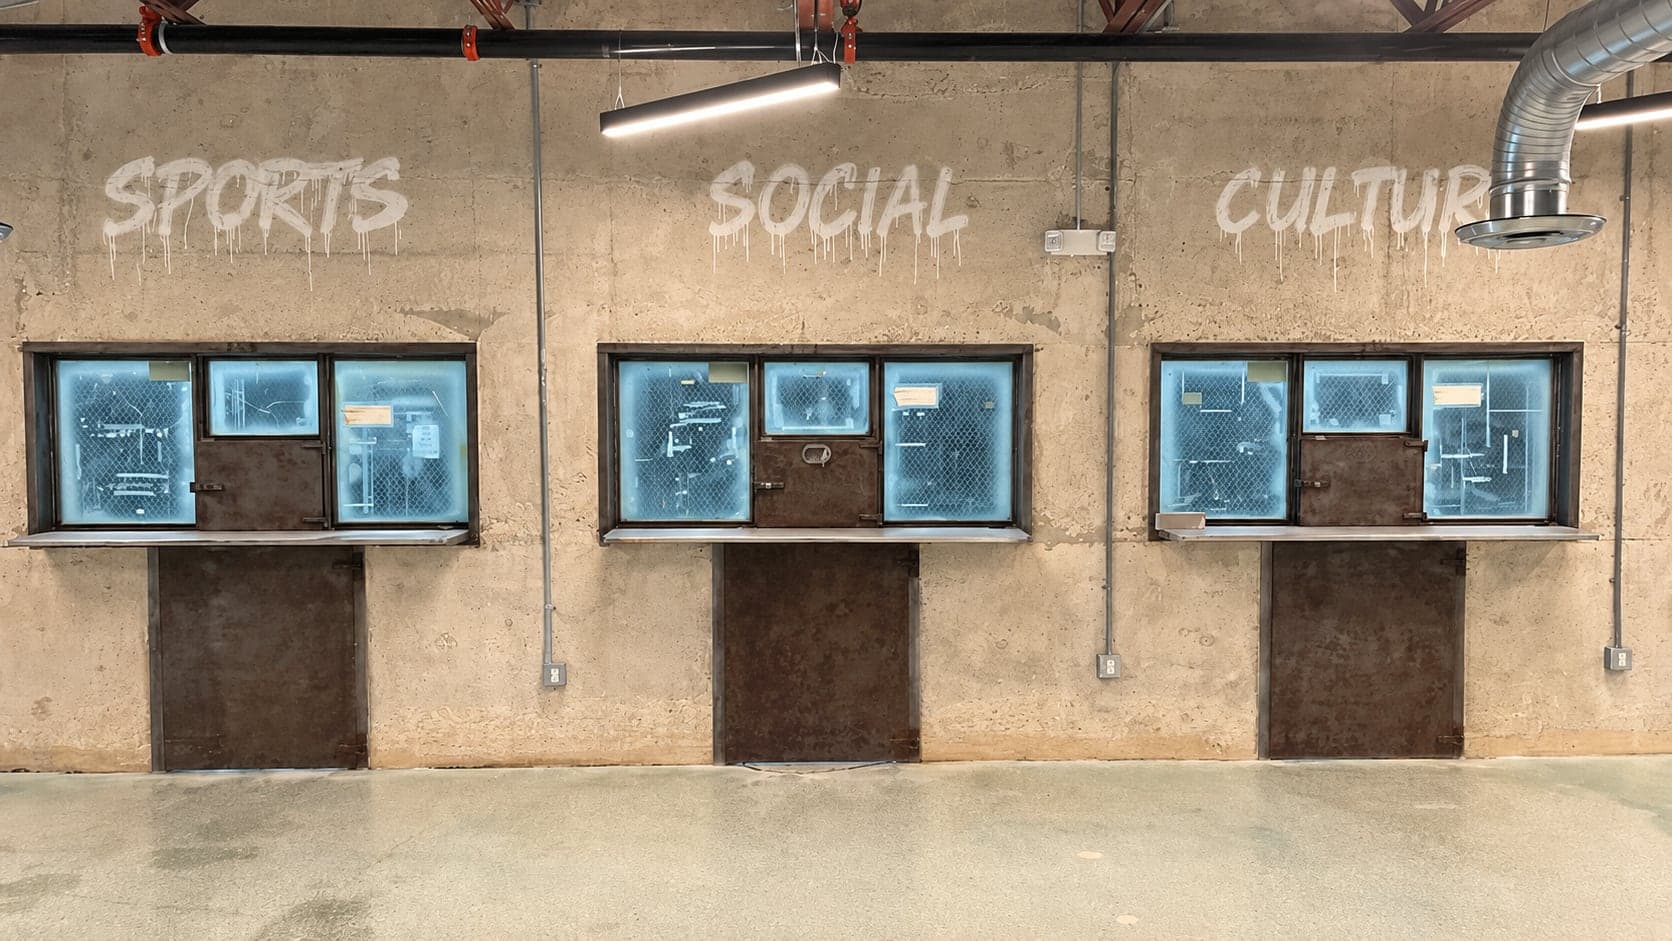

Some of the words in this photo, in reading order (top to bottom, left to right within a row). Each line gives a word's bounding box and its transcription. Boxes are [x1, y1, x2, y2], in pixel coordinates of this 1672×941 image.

[102, 155, 409, 242] SPORTS
[708, 159, 969, 242] SOCIAL
[1215, 163, 1493, 241] CULTUR
